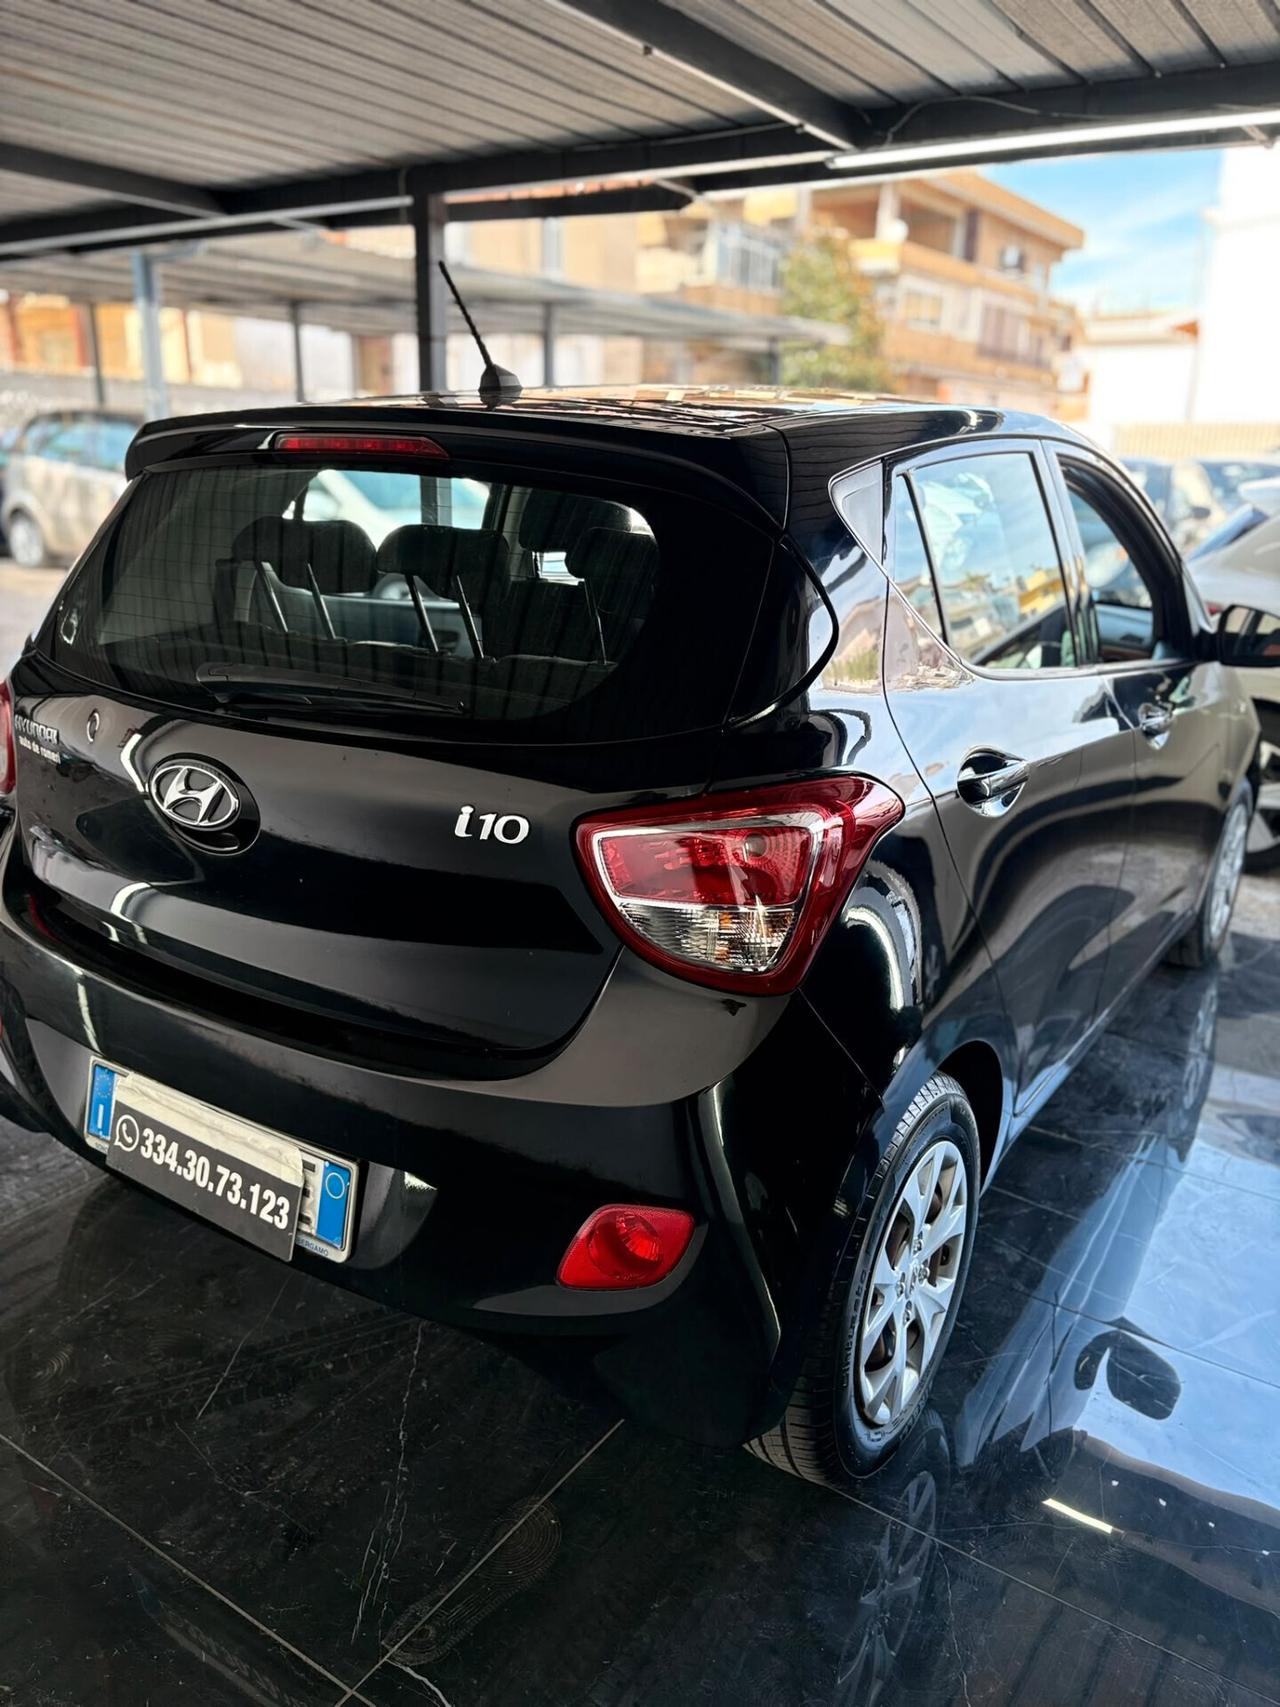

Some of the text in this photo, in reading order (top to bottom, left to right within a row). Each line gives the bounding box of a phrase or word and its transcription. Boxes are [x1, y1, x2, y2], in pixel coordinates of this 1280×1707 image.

[14, 714, 58, 745] HYUNDAI
[454, 805, 530, 845] i10
[97, 1103, 104, 1130] I
[140, 1127, 291, 1231] 334.30.73.123
